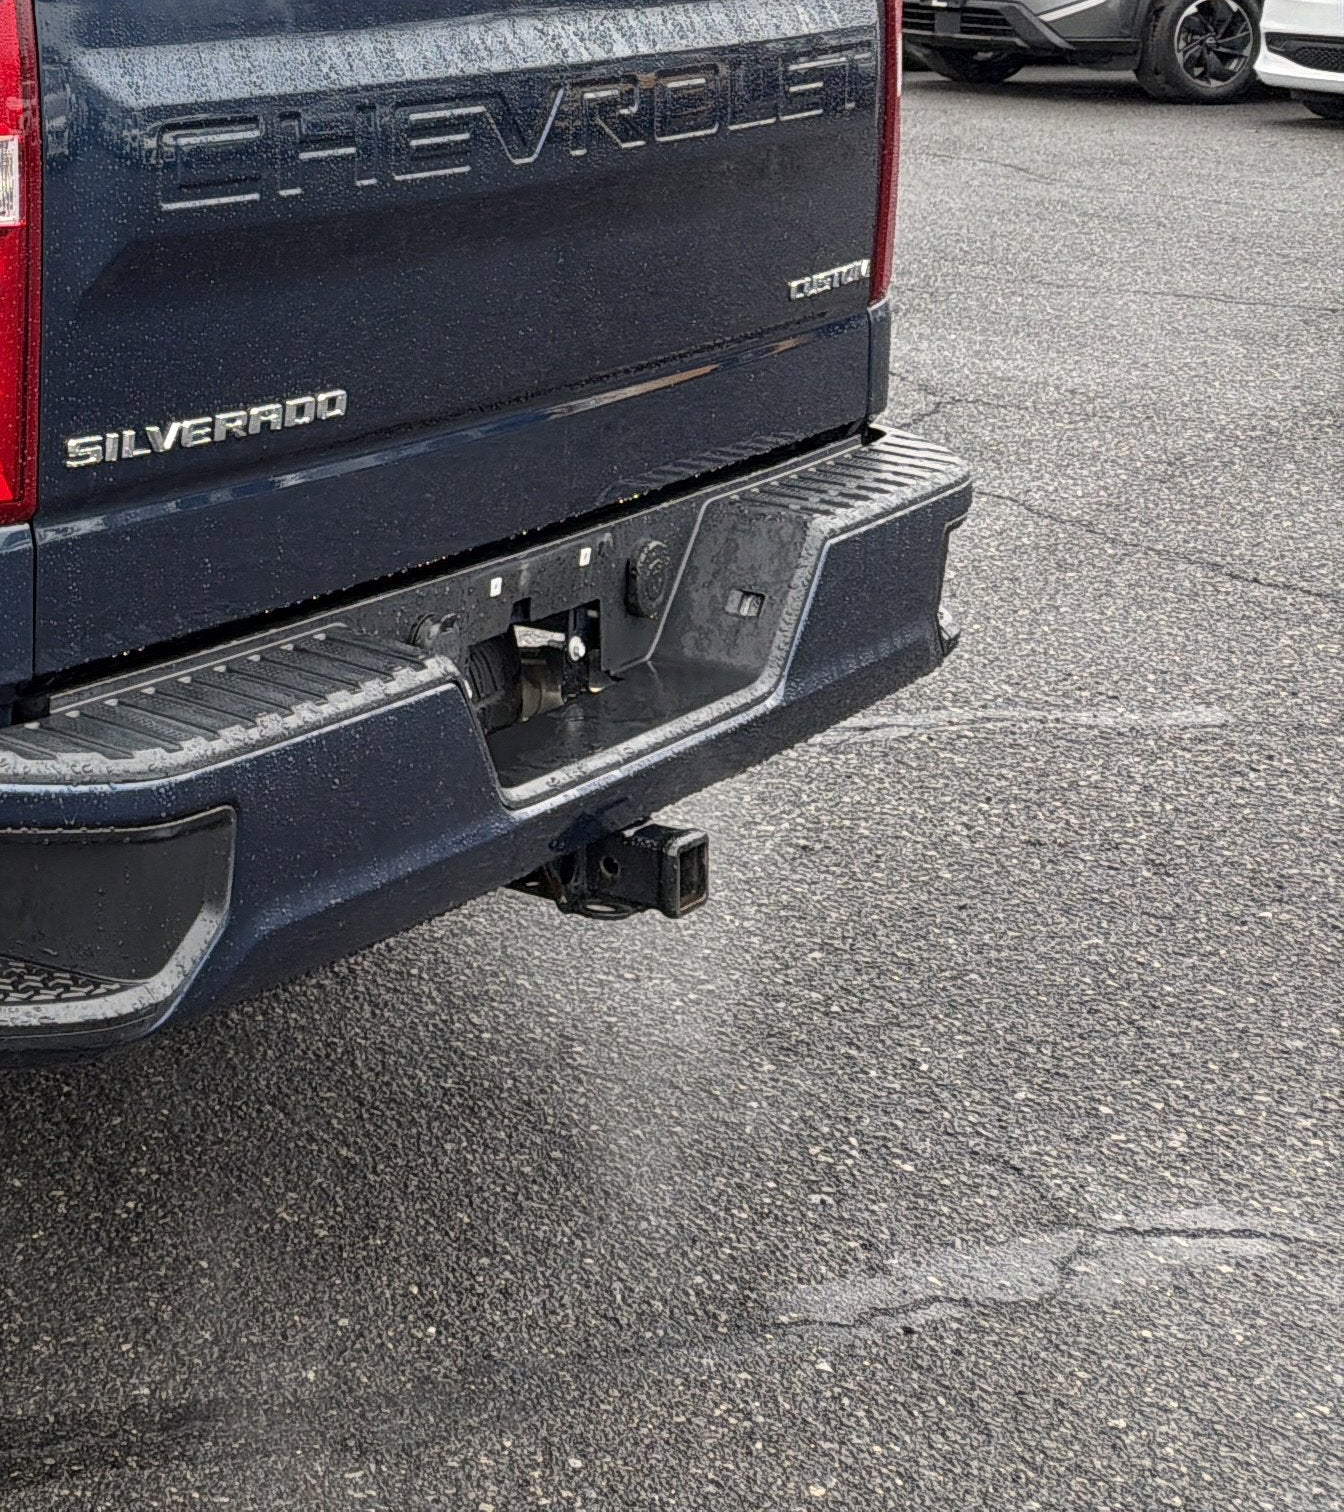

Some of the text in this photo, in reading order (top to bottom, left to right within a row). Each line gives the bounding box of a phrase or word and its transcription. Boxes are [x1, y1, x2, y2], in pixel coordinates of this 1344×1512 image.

[152, 44, 872, 212] CHEVROLET
[788, 258, 870, 300] CUSTOM
[65, 389, 347, 468] SILVERADO
